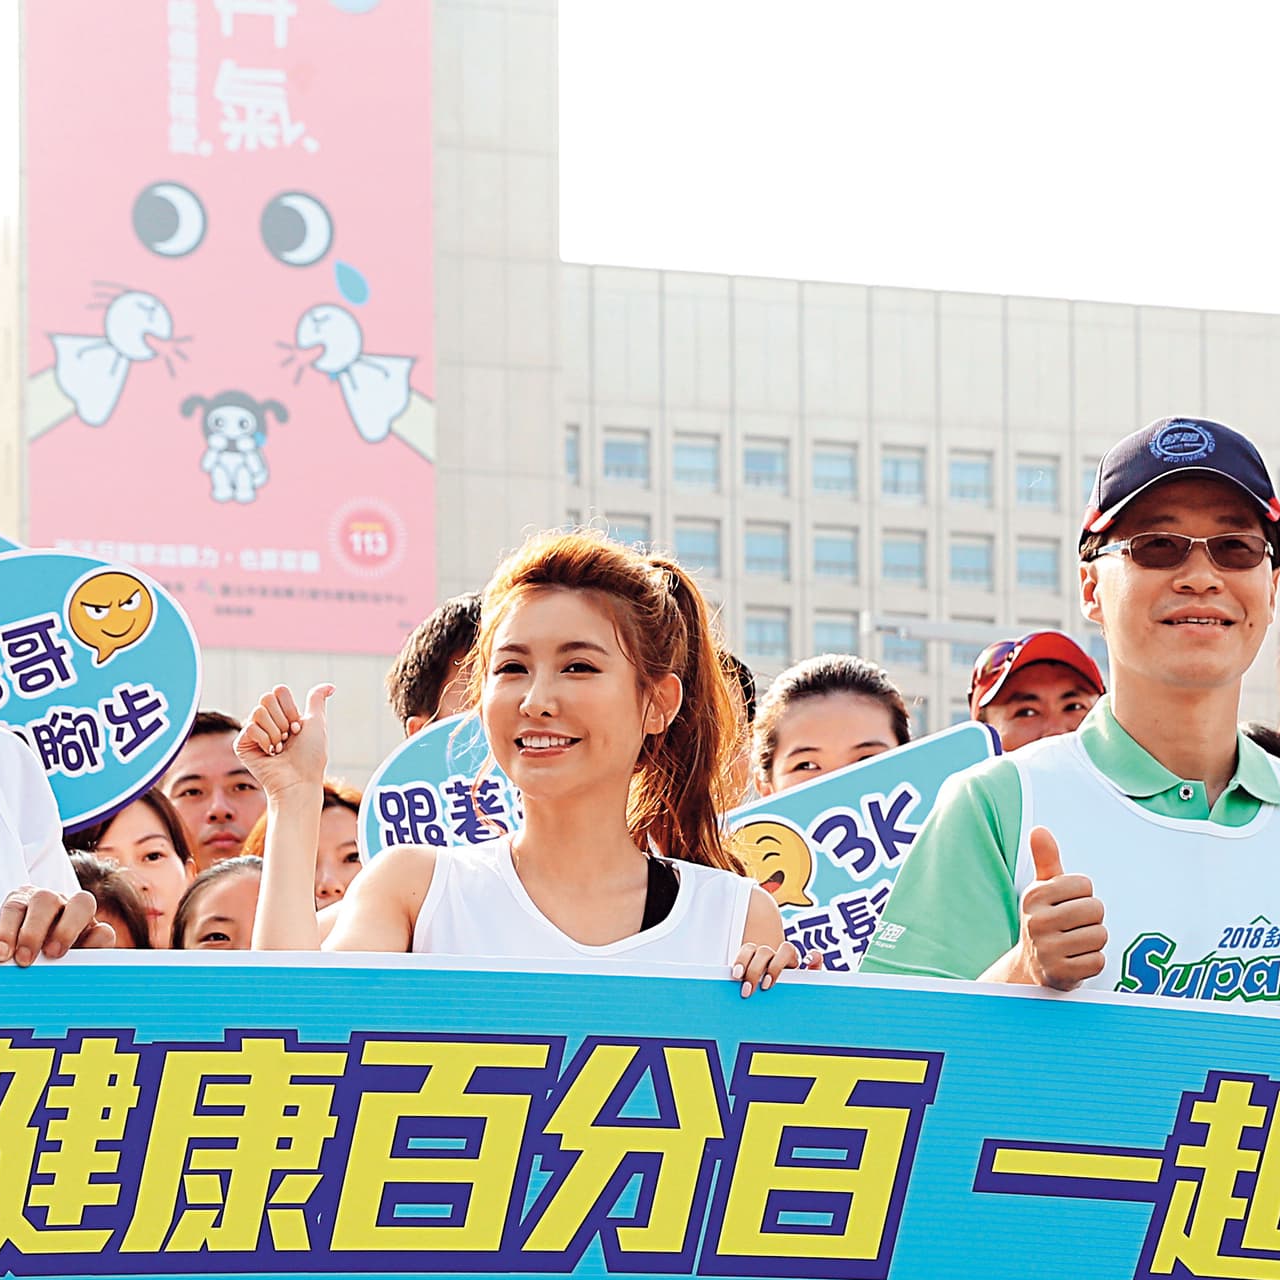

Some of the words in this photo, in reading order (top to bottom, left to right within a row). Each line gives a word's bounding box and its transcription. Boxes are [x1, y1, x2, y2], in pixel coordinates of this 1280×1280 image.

[13, 689, 164, 770] 腳步
[380, 780, 523, 846] 跟著
[812, 790, 916, 874] 3K
[1219, 926, 1265, 951] 2018
